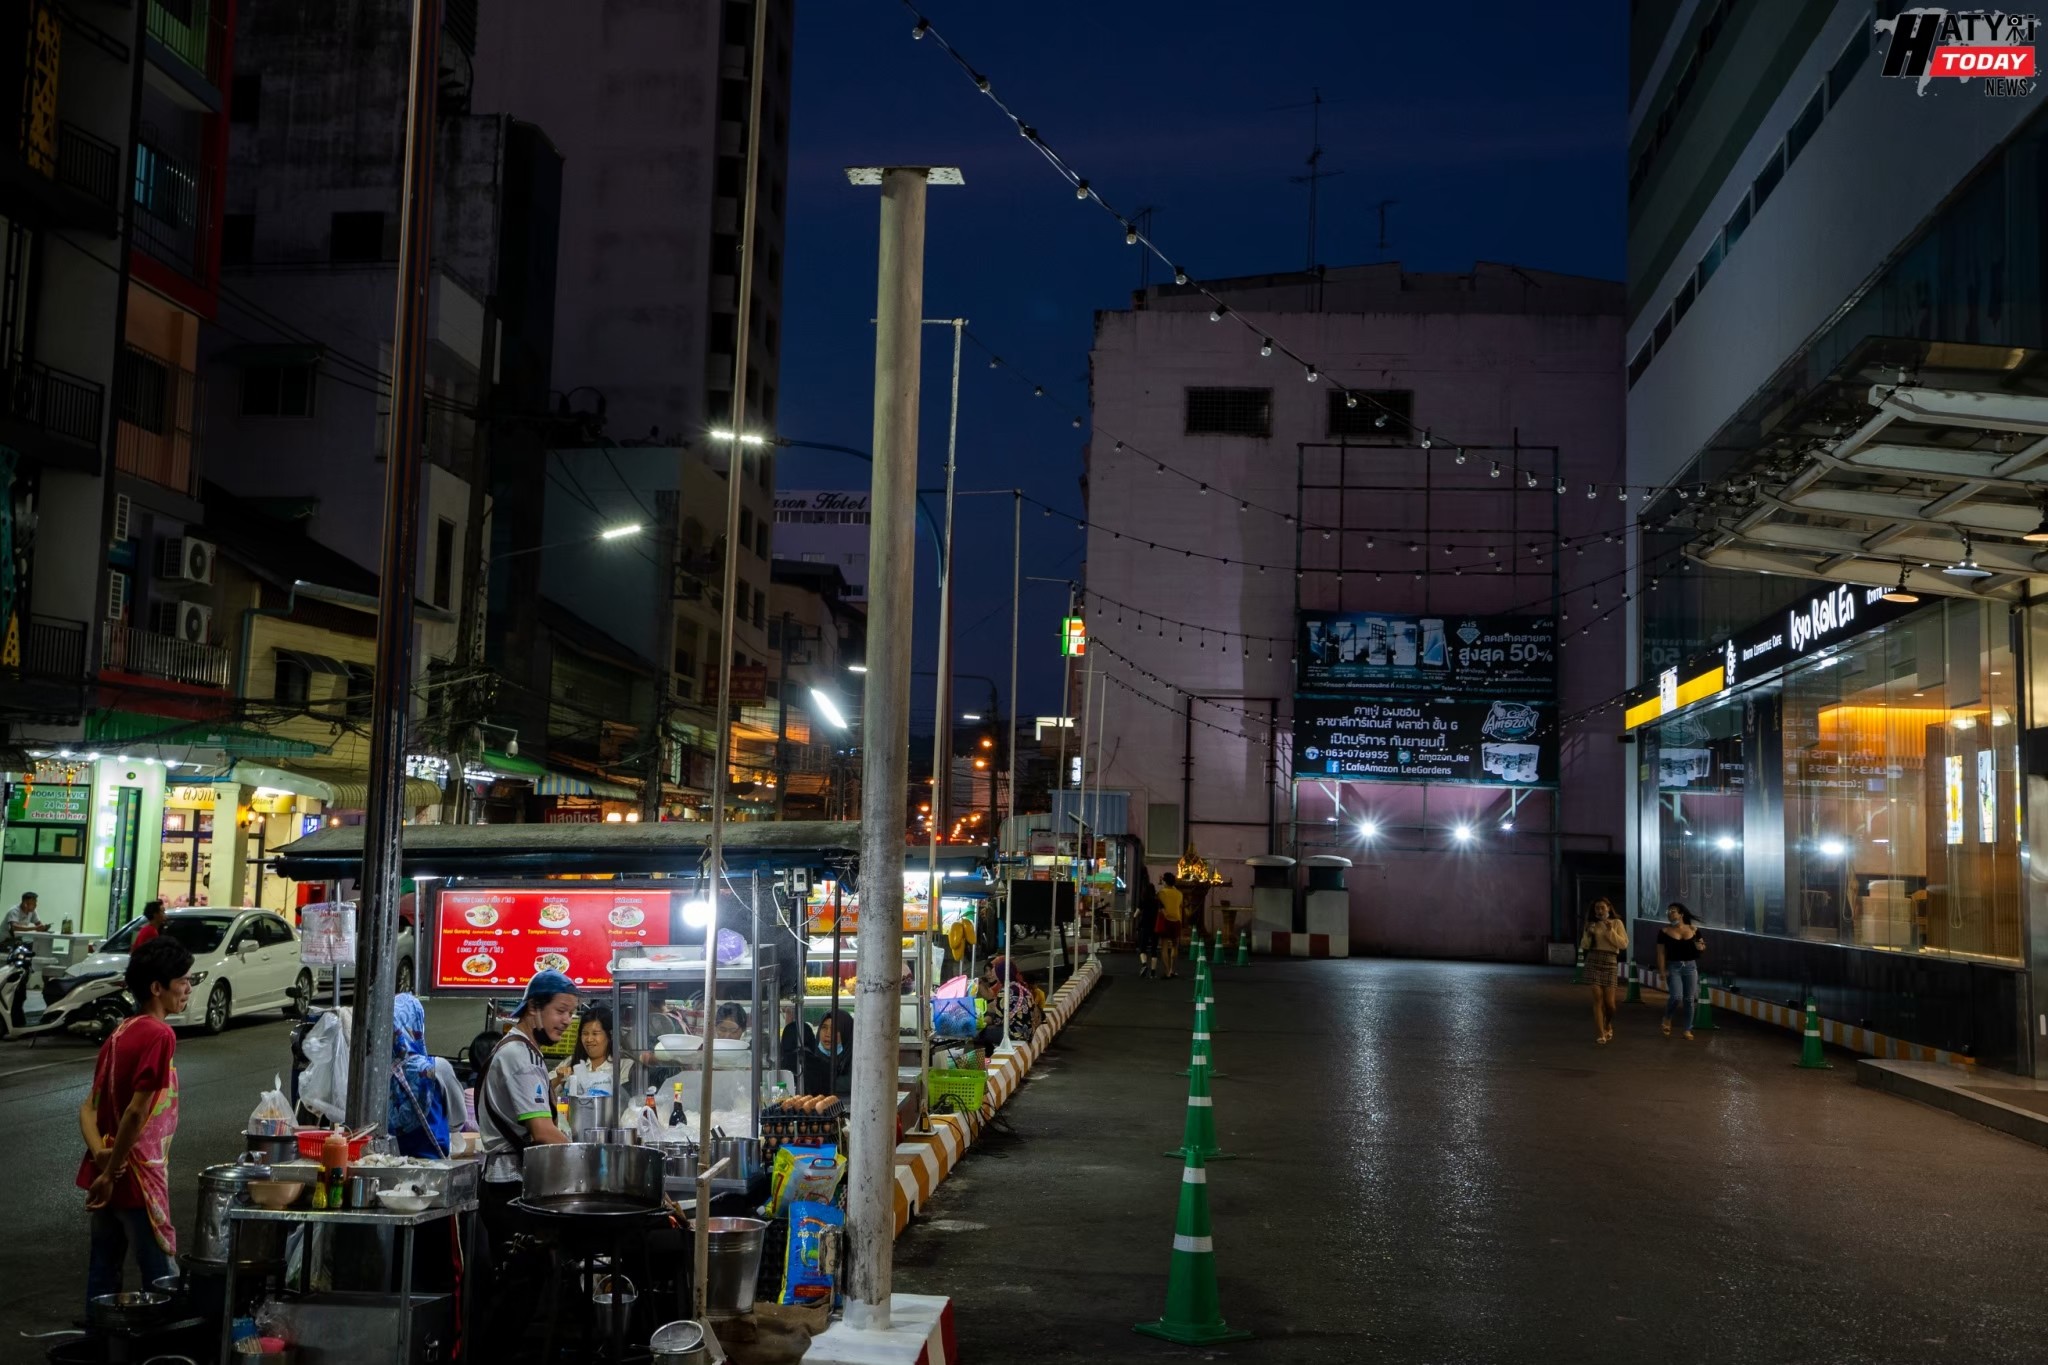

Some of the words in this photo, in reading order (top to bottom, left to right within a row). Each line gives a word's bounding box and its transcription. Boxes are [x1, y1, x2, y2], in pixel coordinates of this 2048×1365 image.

[812, 492, 867, 510] Hotel
[1460, 620, 1478, 628] AIS
[1459, 647, 1505, 667] สูงสุด
[1509, 643, 1554, 662] 50%
[1382, 706, 1420, 717] อมซอน
[1396, 717, 1430, 730] พลาซ่า
[1432, 716, 1447, 730] ชั้น
[1450, 721, 1459, 730] G
[1330, 732, 1387, 746] เปิดบริการ
[1346, 761, 1398, 774] CafeAmazon
[1401, 764, 1452, 776] LeeGardens
[44, 801, 54, 809] 24
